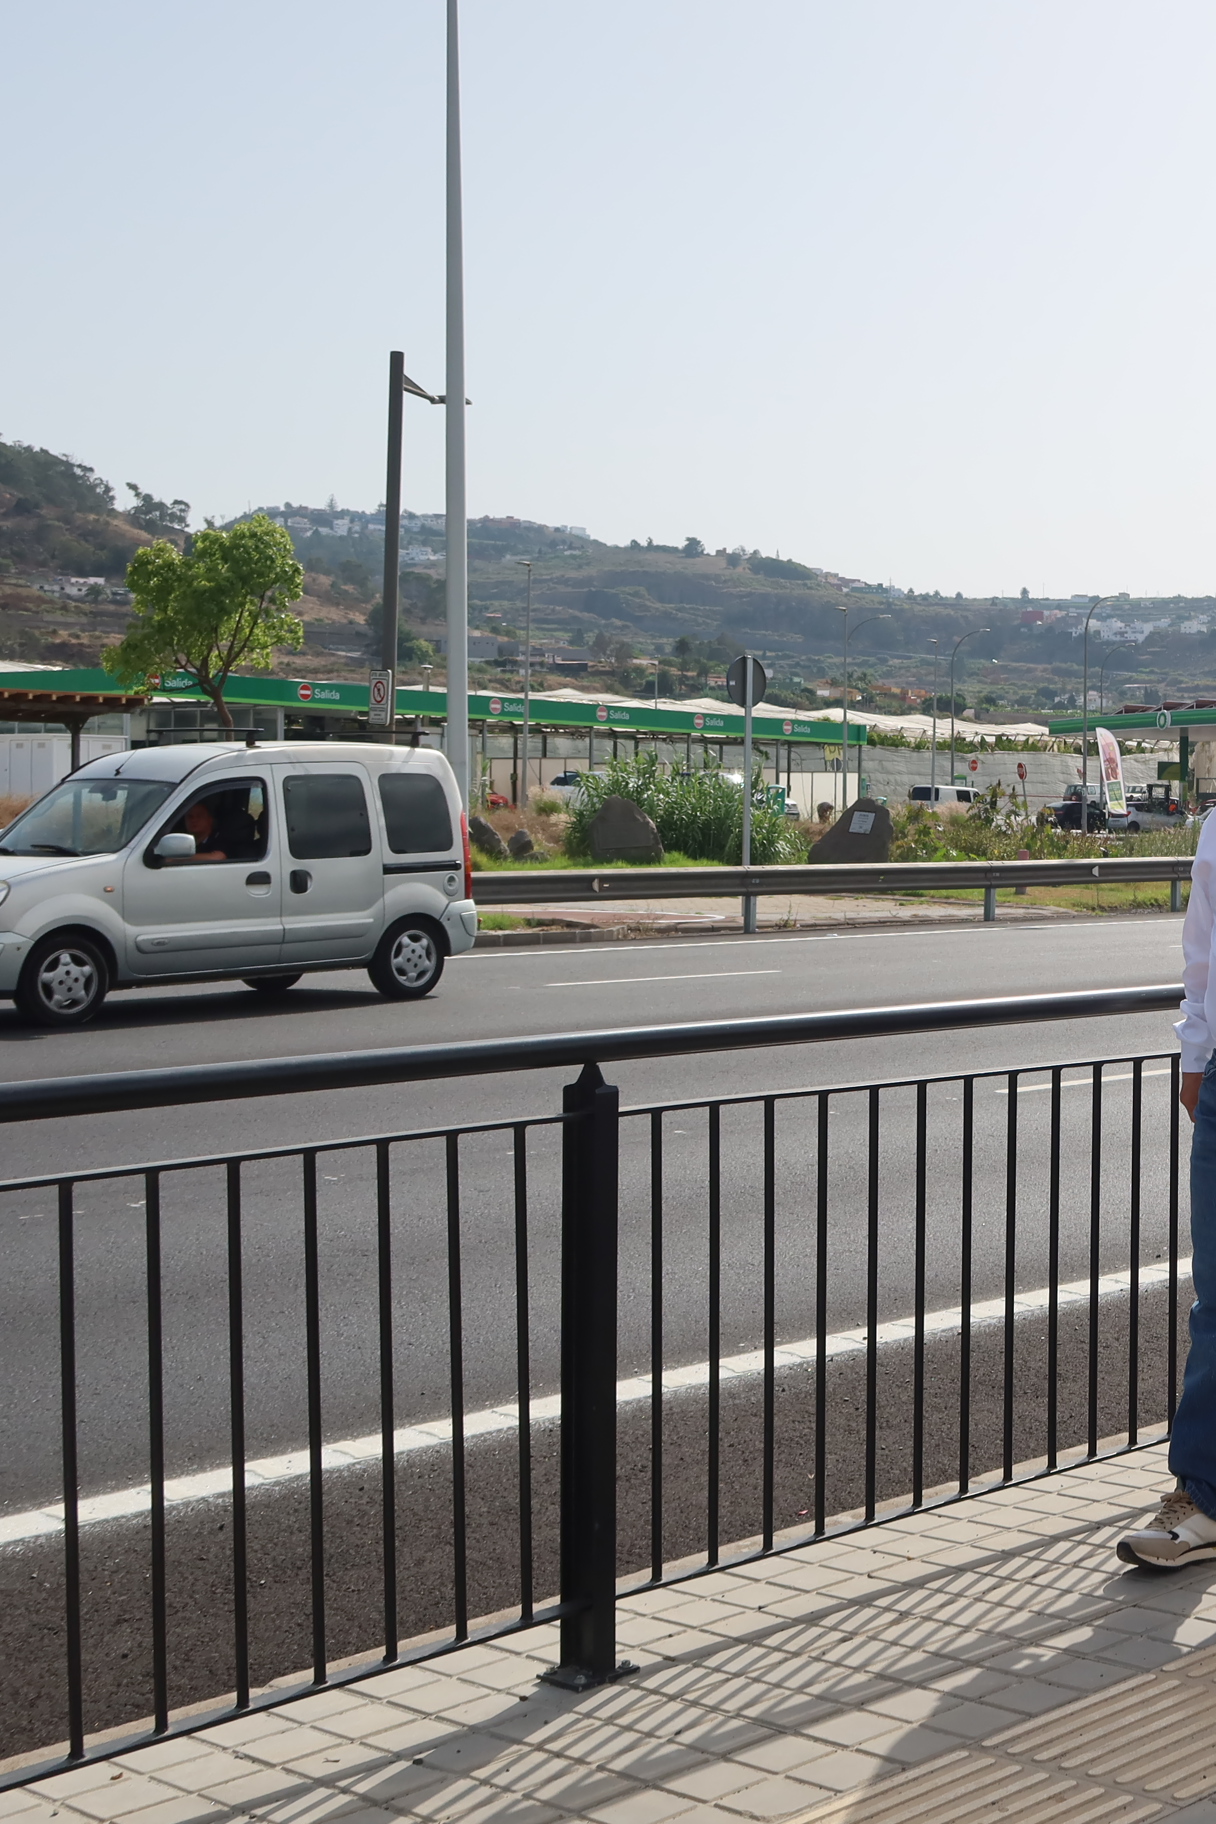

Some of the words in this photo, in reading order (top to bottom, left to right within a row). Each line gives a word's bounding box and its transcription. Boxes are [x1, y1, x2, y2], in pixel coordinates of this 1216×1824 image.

[314, 688, 340, 700] Salida
[609, 710, 630, 720] Salida
[705, 717, 724, 727] Salida
[793, 723, 811, 733] Salida
